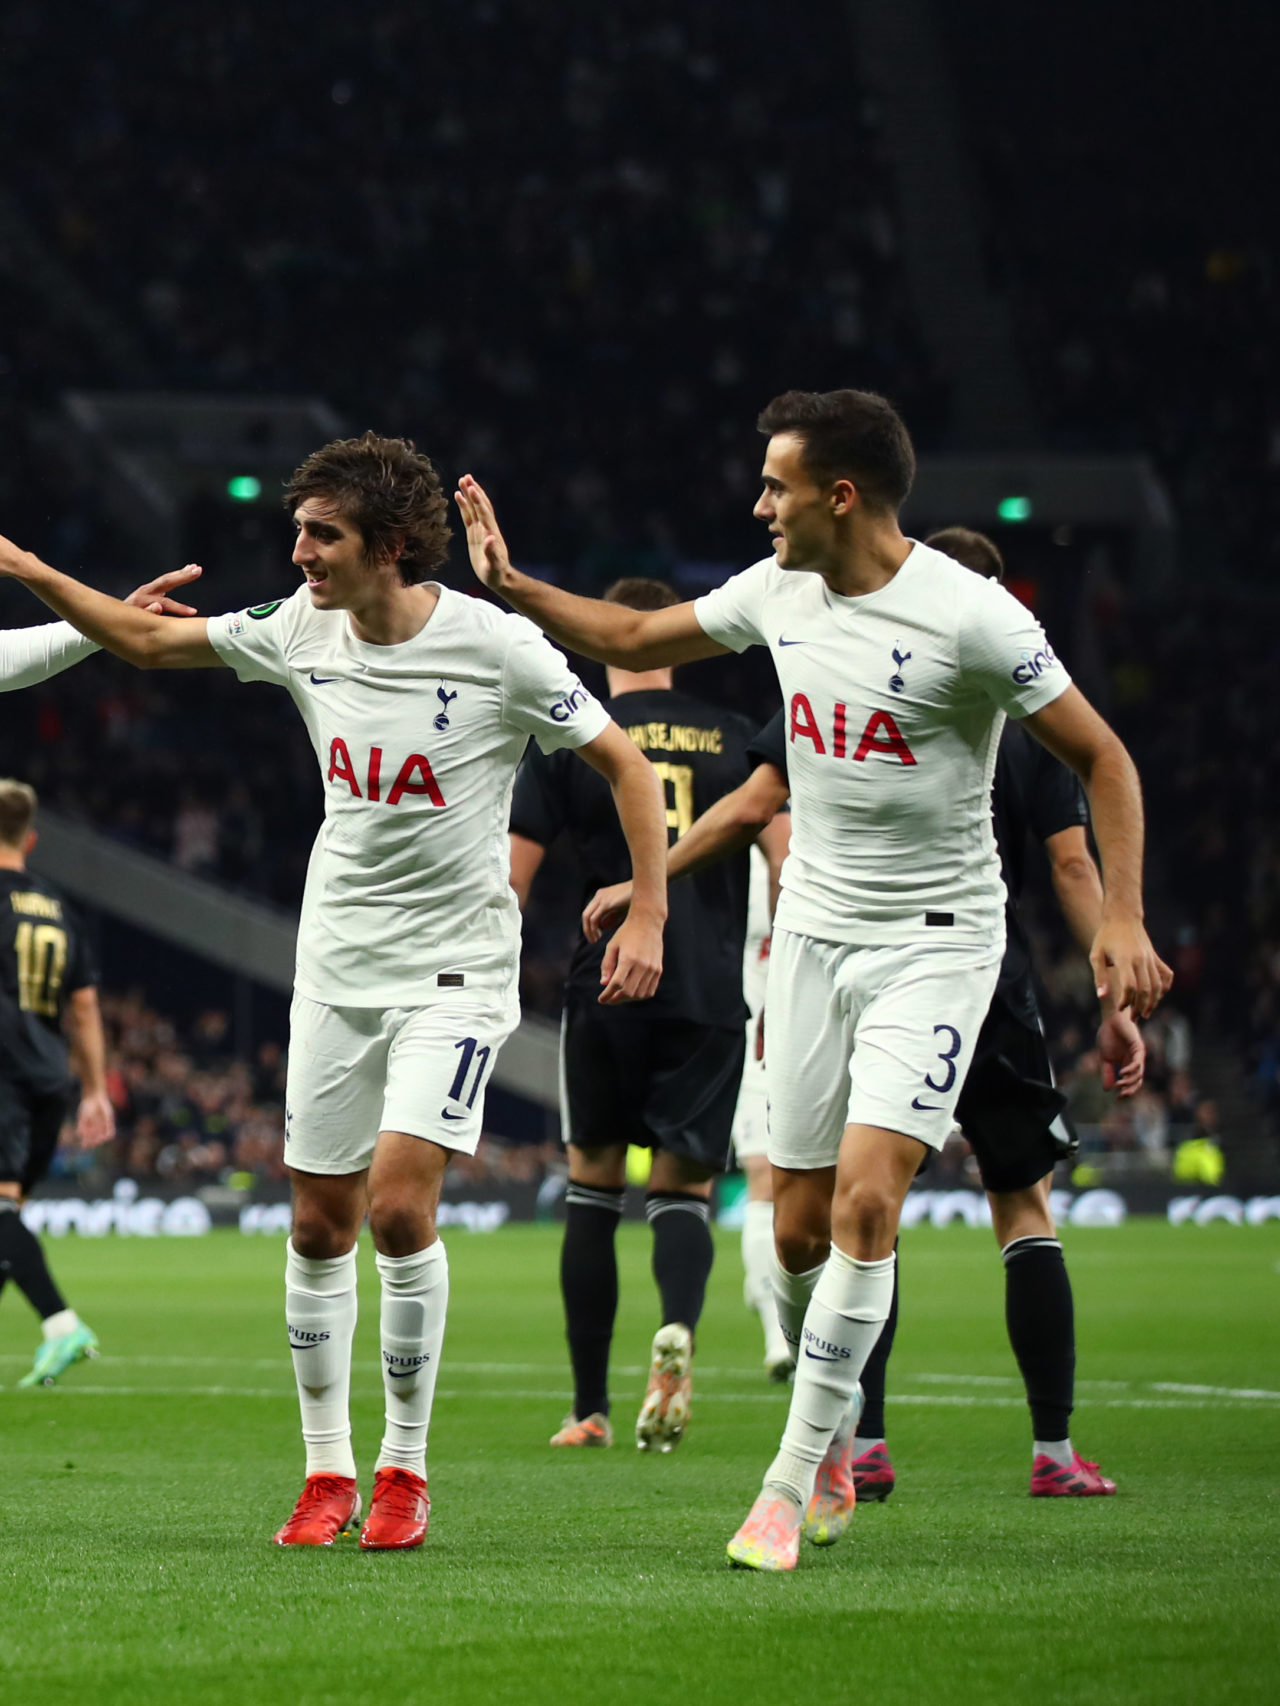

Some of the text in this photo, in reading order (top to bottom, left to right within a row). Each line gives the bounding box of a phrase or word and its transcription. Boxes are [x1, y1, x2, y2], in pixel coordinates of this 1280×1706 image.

[790, 692, 918, 766] AIA
[328, 737, 446, 807] AIA
[15, 921, 67, 1016] 10
[447, 1036, 491, 1110] 11
[924, 1024, 962, 1093] 3
[288, 1325, 332, 1343] PURS
[382, 1350, 431, 1367] SPURS
[803, 1327, 852, 1359] SPURS
